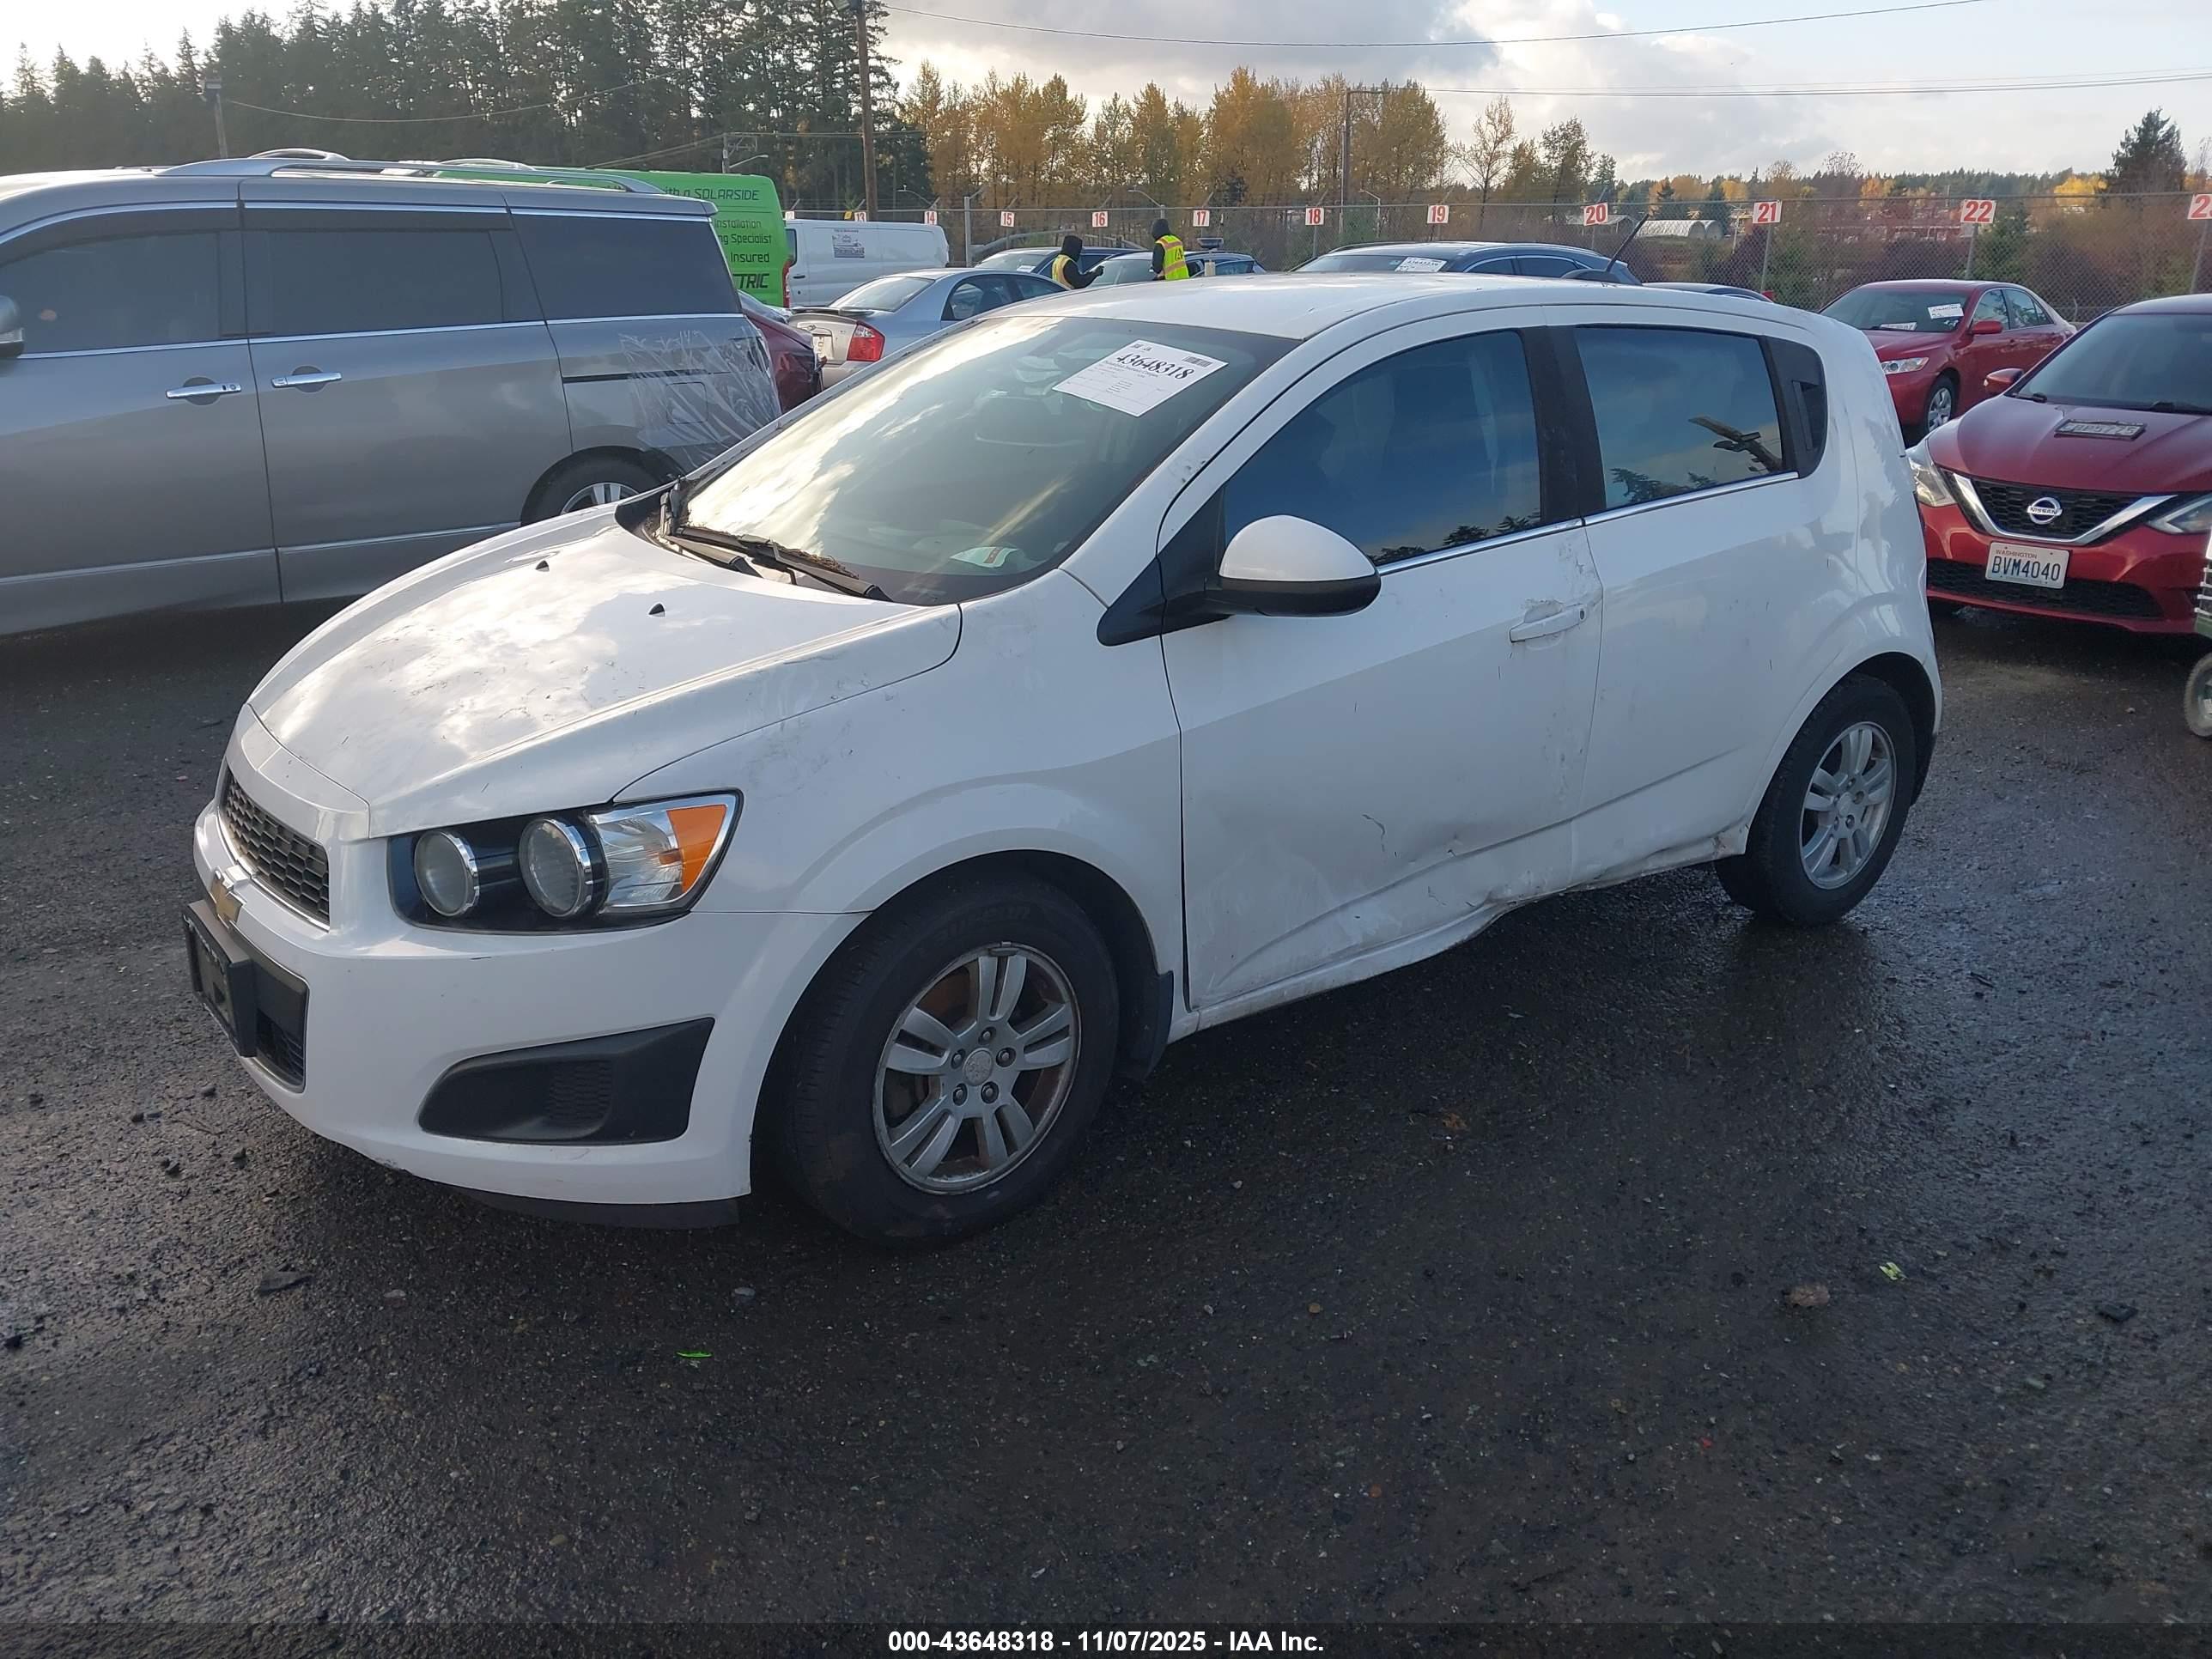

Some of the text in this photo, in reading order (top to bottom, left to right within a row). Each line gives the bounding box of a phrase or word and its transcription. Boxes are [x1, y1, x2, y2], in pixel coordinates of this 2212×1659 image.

[693, 188, 760, 201] SOLARSIDE
[1431, 206, 1445, 222] 19
[1757, 203, 1778, 222] 21
[1965, 201, 1993, 222] 22
[2191, 195, 2212, 218] 2
[856, 213, 866, 222] 13
[926, 212, 936, 224] 14
[1003, 212, 1012, 226] 15
[1095, 212, 1106, 226] 16
[1196, 211, 1206, 226] 17
[1308, 208, 1321, 224] 18
[1586, 206, 1607, 223] 20
[714, 218, 762, 228] Installation
[731, 234, 772, 245] Specialist
[731, 252, 769, 263] Insured
[732, 273, 770, 289] TRIC
[1115, 352, 1196, 380] 43648318
[1996, 549, 2038, 559] WASHINGTON
[1991, 556, 2061, 581] BVM4040
